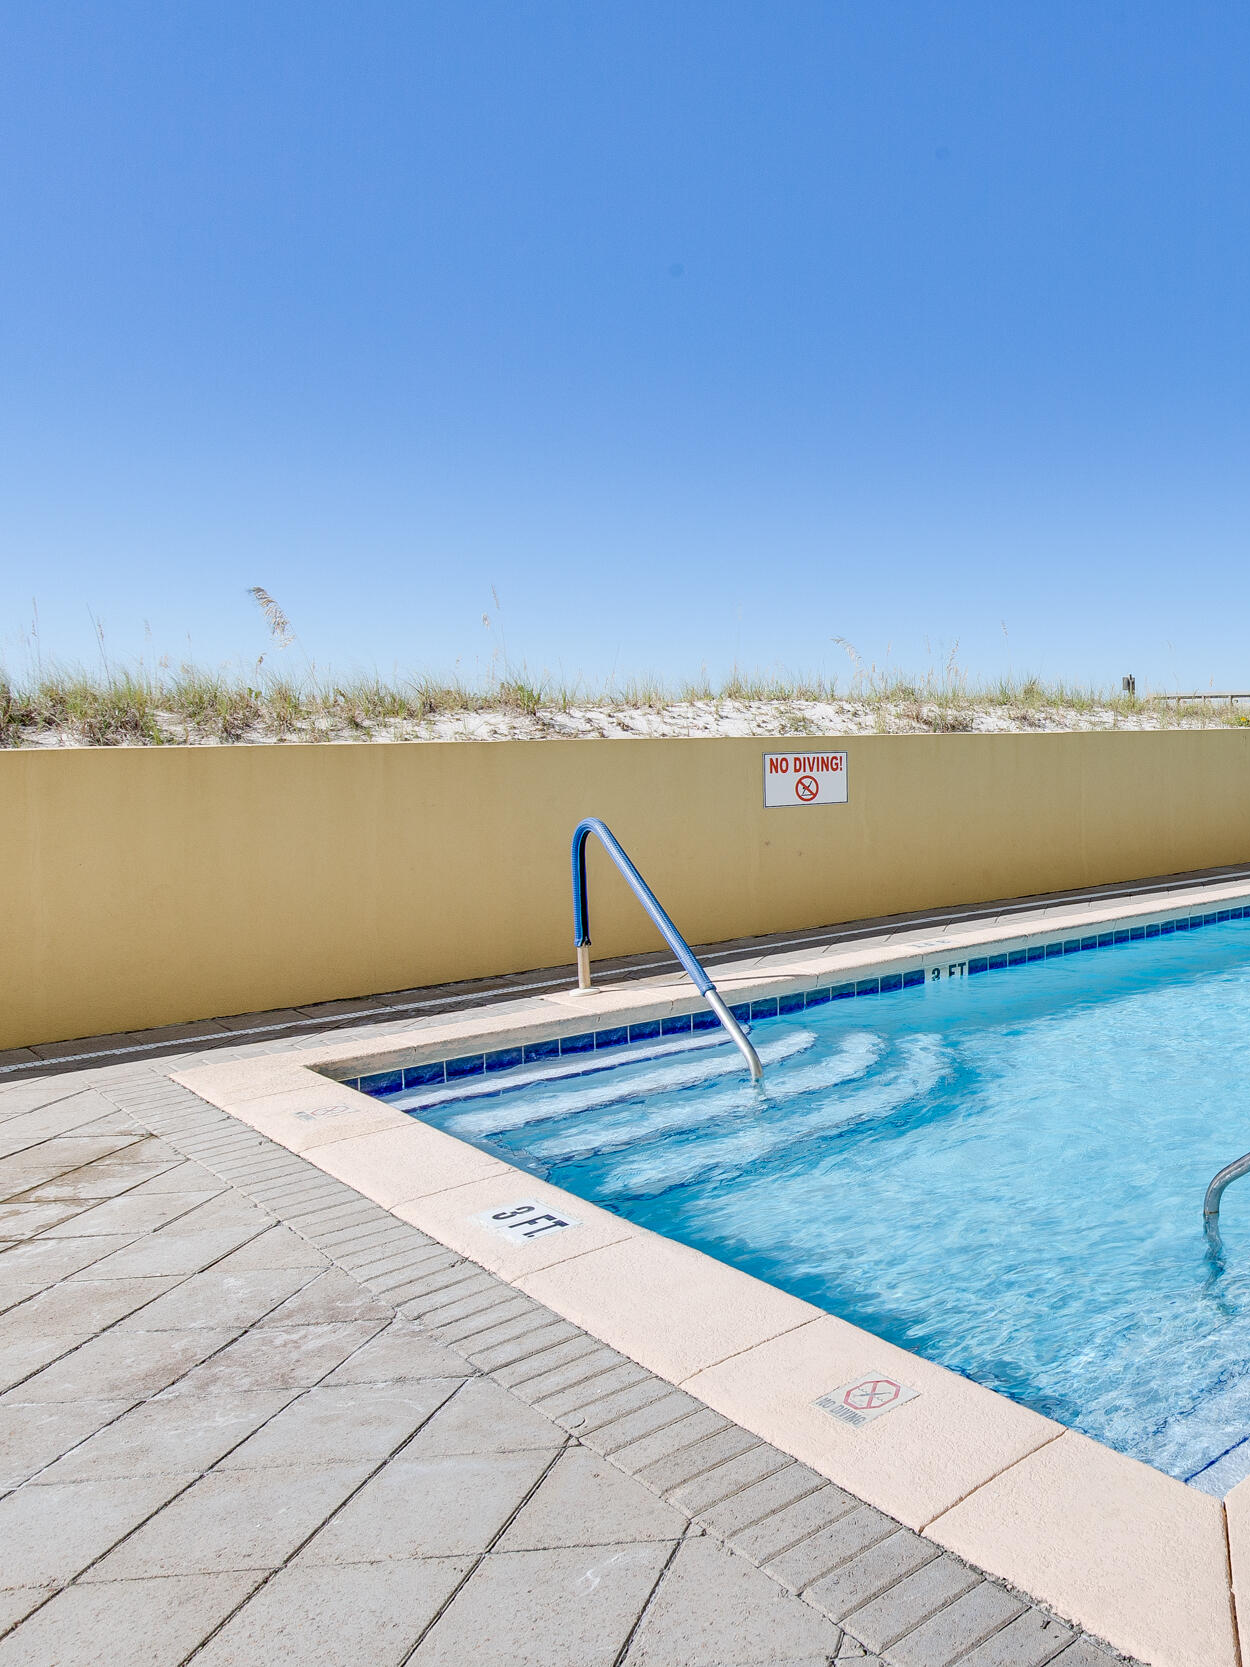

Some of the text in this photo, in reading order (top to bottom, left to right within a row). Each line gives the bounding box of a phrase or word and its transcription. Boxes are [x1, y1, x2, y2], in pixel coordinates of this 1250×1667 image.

[769, 756, 843, 774] NO DIVING!
[931, 962, 967, 982] 3 FT
[492, 1205, 535, 1220] 3
[815, 1396, 867, 1425] NO DIVING
